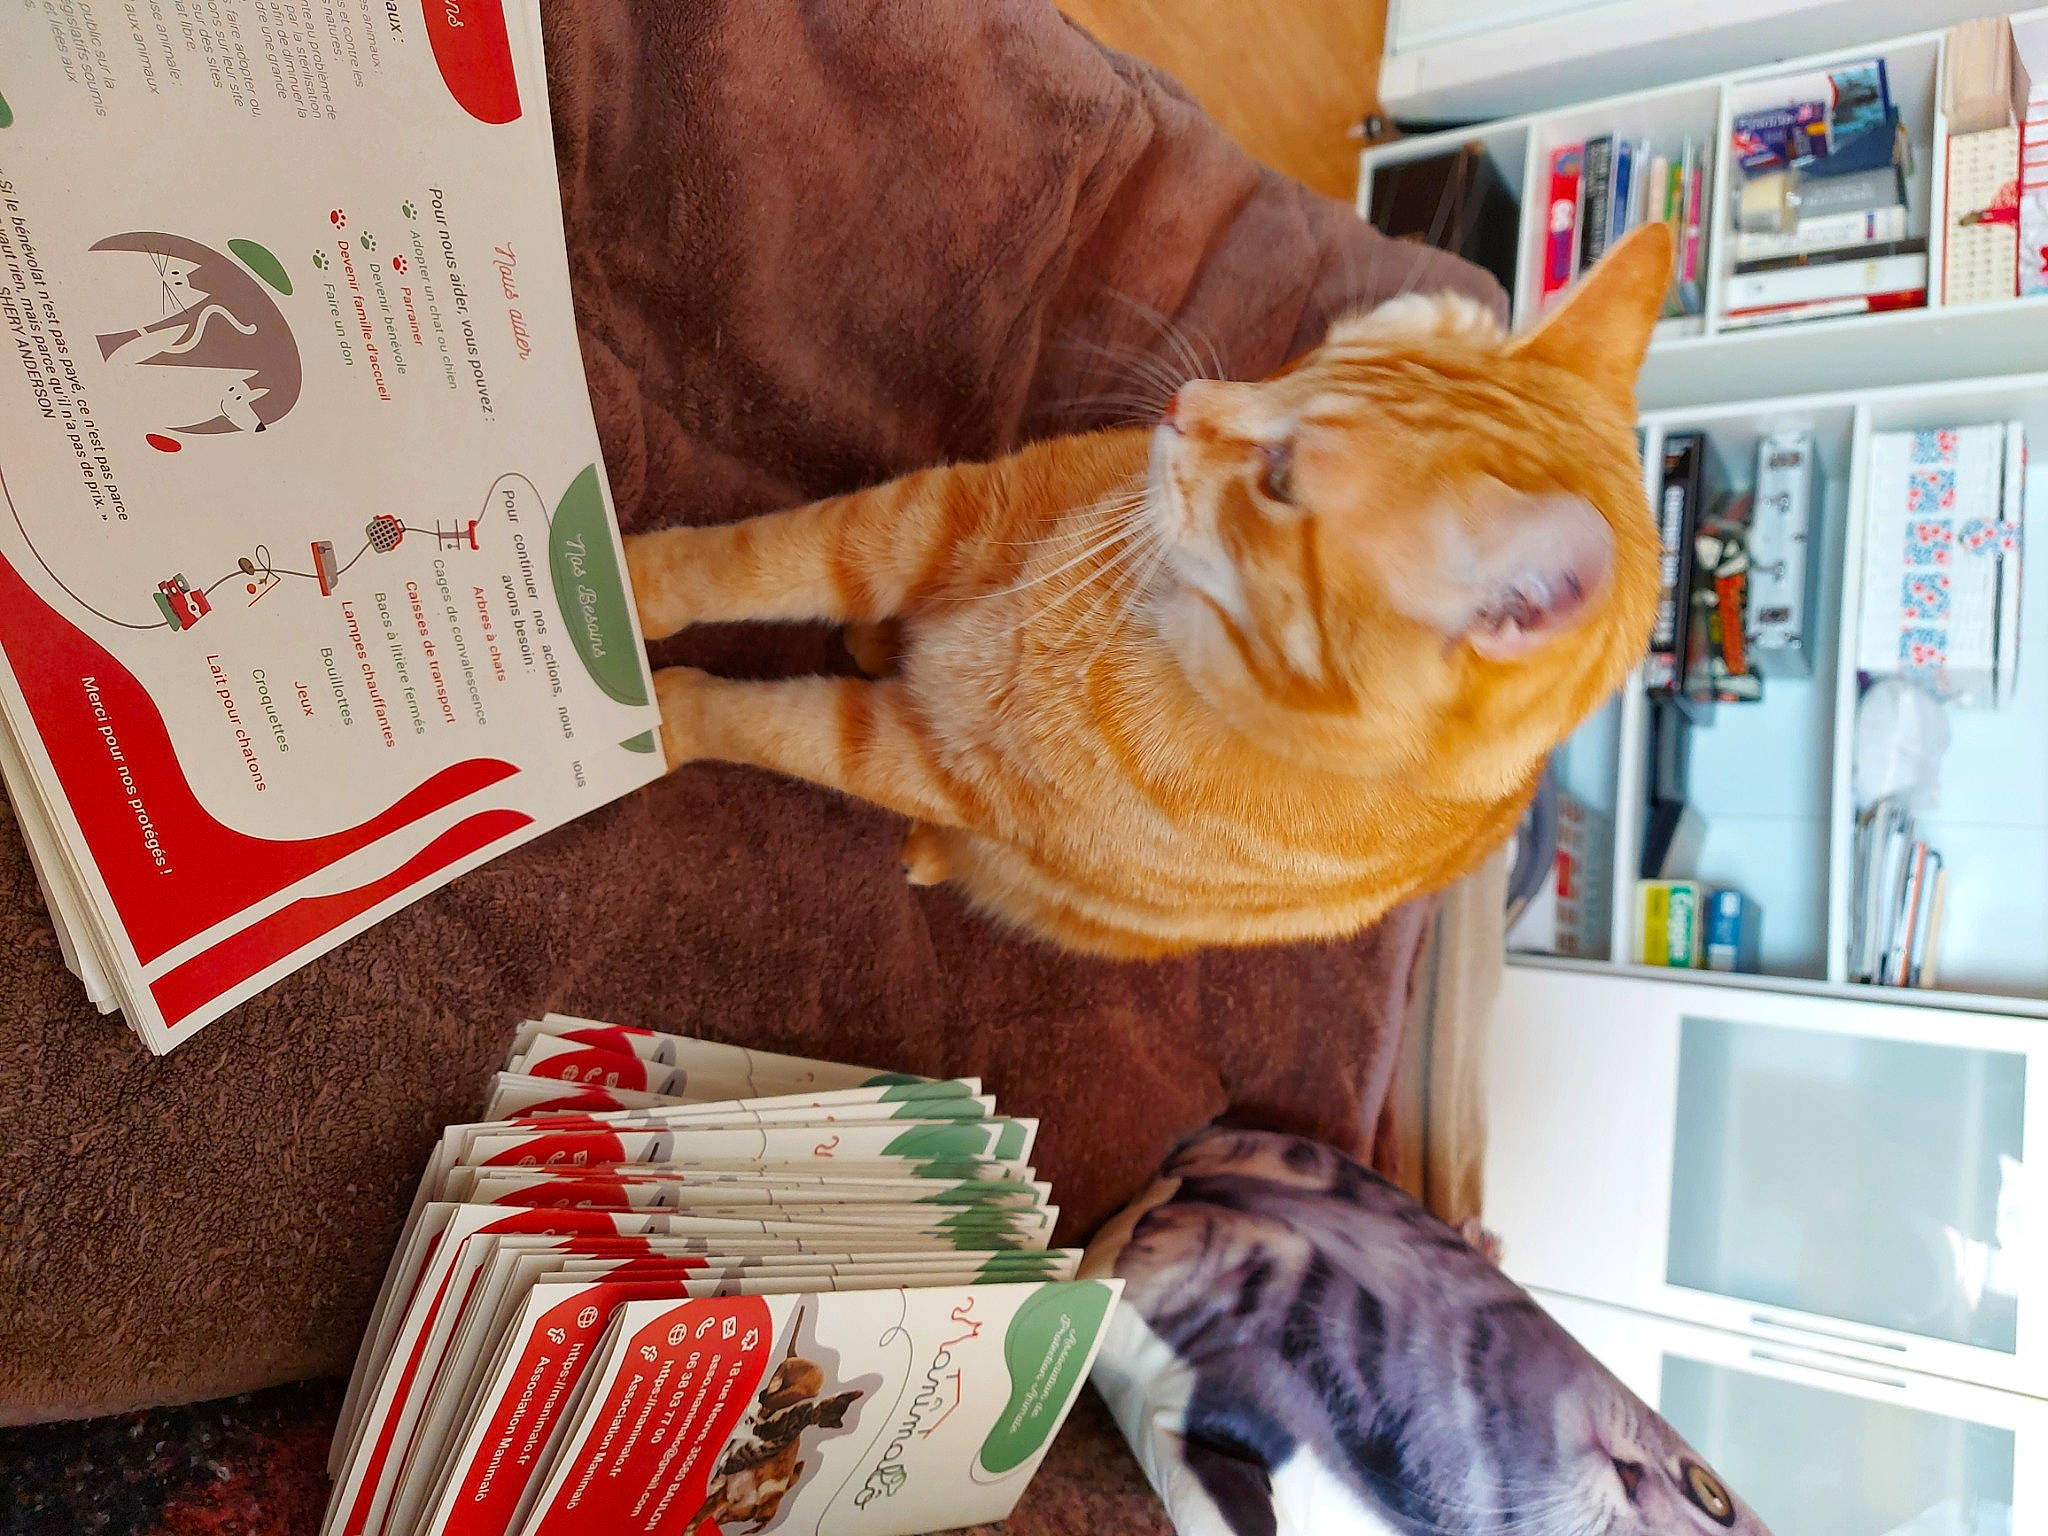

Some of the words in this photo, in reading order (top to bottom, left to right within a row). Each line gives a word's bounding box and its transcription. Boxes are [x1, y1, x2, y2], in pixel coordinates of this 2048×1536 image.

[270, 2, 285, 27] afin
[284, 3, 298, 27] par
[293, 31, 304, 43] la
[305, 21, 316, 39] au
[324, 7, 342, 56] natures
[339, 11, 350, 24] et
[385, 0, 402, 33] aux
[123, 3, 141, 31] aux
[132, 33, 160, 95] animaux
[192, 3, 206, 25] sur
[199, 29, 213, 53] des
[206, 57, 223, 88] sites
[215, 30, 229, 52] sur
[226, 10, 241, 39] faire
[234, 42, 256, 95] adopter
[261, 26, 275, 51] une
[277, 29, 290, 46] de
[342, 26, 359, 67] contre
[362, 13, 380, 67] animaux
[61, 56, 78, 83] aux
[95, 50, 111, 74] sur
[103, 76, 116, 89] la
[222, 55, 237, 80] leur
[265, 53, 287, 99] grande
[281, 49, 304, 105] diminuer
[308, 40, 332, 102] problème
[352, 68, 364, 88] les
[229, 83, 244, 107] site
[325, 104, 336, 120] de
[296, 107, 308, 119] la
[0, 180, 16, 194] Si
[4, 198, 19, 212] le
[429, 188, 447, 226] Pour
[10, 216, 47, 286] bénévolat
[410, 230, 430, 282] Adopter
[439, 230, 457, 269] nous
[8, 263, 26, 293] rien,
[424, 285, 435, 302] un
[449, 273, 469, 314] aider,
[20, 298, 42, 331] mais
[38, 291, 60, 324] n'est
[323, 283, 340, 316] Faire
[400, 287, 423, 345] Parrainer
[493, 242, 520, 300] Nous
[509, 309, 532, 360] aider
[334, 320, 346, 337] un
[337, 240, 359, 291] Devenir
[353, 295, 372, 340] famille
[366, 343, 391, 401] d'accueil
[369, 263, 390, 313] Devenir
[384, 316, 407, 375] bénévole
[429, 305, 444, 333] chat
[0, 286, 26, 336] SHERY
[15, 338, 56, 418] ANDERSON
[30, 335, 56, 374] parce
[48, 329, 68, 354] pas
[339, 341, 353, 366] don
[437, 336, 448, 353] ou
[461, 320, 478, 355] vous
[59, 359, 86, 394] payé,
[442, 355, 457, 390] chien
[468, 359, 493, 413] pouvez
[48, 377, 72, 406] qu'il
[76, 399, 90, 415] ce
[60, 410, 77, 430] n'a
[83, 420, 106, 452] n'est
[66, 434, 87, 458] pas
[80, 461, 94, 478] de
[93, 456, 113, 480] pas
[84, 481, 106, 509] prix.
[104, 484, 128, 521] parce
[375, 592, 392, 628] Bacs
[406, 581, 429, 636] Caisses
[473, 586, 492, 630] Arbres
[565, 533, 587, 577] Nos
[577, 584, 606, 658] Besoins
[502, 490, 519, 523] Pour
[513, 534, 538, 599] continuer
[533, 610, 547, 635] nos
[542, 645, 563, 697] actions,
[558, 706, 574, 739] nous
[502, 575, 521, 616] avons
[514, 619, 533, 665] besoin
[386, 632, 398, 641] à
[423, 640, 436, 657] de
[433, 559, 452, 602] Cages
[446, 606, 458, 623] de
[452, 626, 487, 725] convalescence
[486, 634, 497, 642] à
[206, 655, 228, 686] Lait
[341, 601, 367, 659] Lampes
[362, 663, 395, 747] chauffantes
[390, 644, 409, 683] litière
[490, 645, 506, 682] chats
[294, 681, 314, 716] Jeux
[320, 647, 353, 726] Bouillottes
[429, 661, 456, 723] transport
[216, 689, 242, 724] pour
[252, 669, 289, 752] Croquettes
[403, 686, 425, 735] fermés
[81, 676, 111, 722] Merci
[97, 725, 125, 762] pour
[117, 766, 137, 795] nos
[128, 798, 166, 867] protégés
[235, 729, 266, 792] chatons
[686, 1351, 701, 1370] 06
[729, 1360, 743, 1377] 18
[505, 1356, 551, 1435] Association
[677, 1372, 693, 1389] 38
[718, 1378, 734, 1400] rue
[517, 1343, 584, 1465] https://manimalo.fr
[599, 1373, 644, 1450] Association
[669, 1391, 685, 1408] 03
[660, 1410, 676, 1425] 77
[650, 1427, 666, 1444] 00
